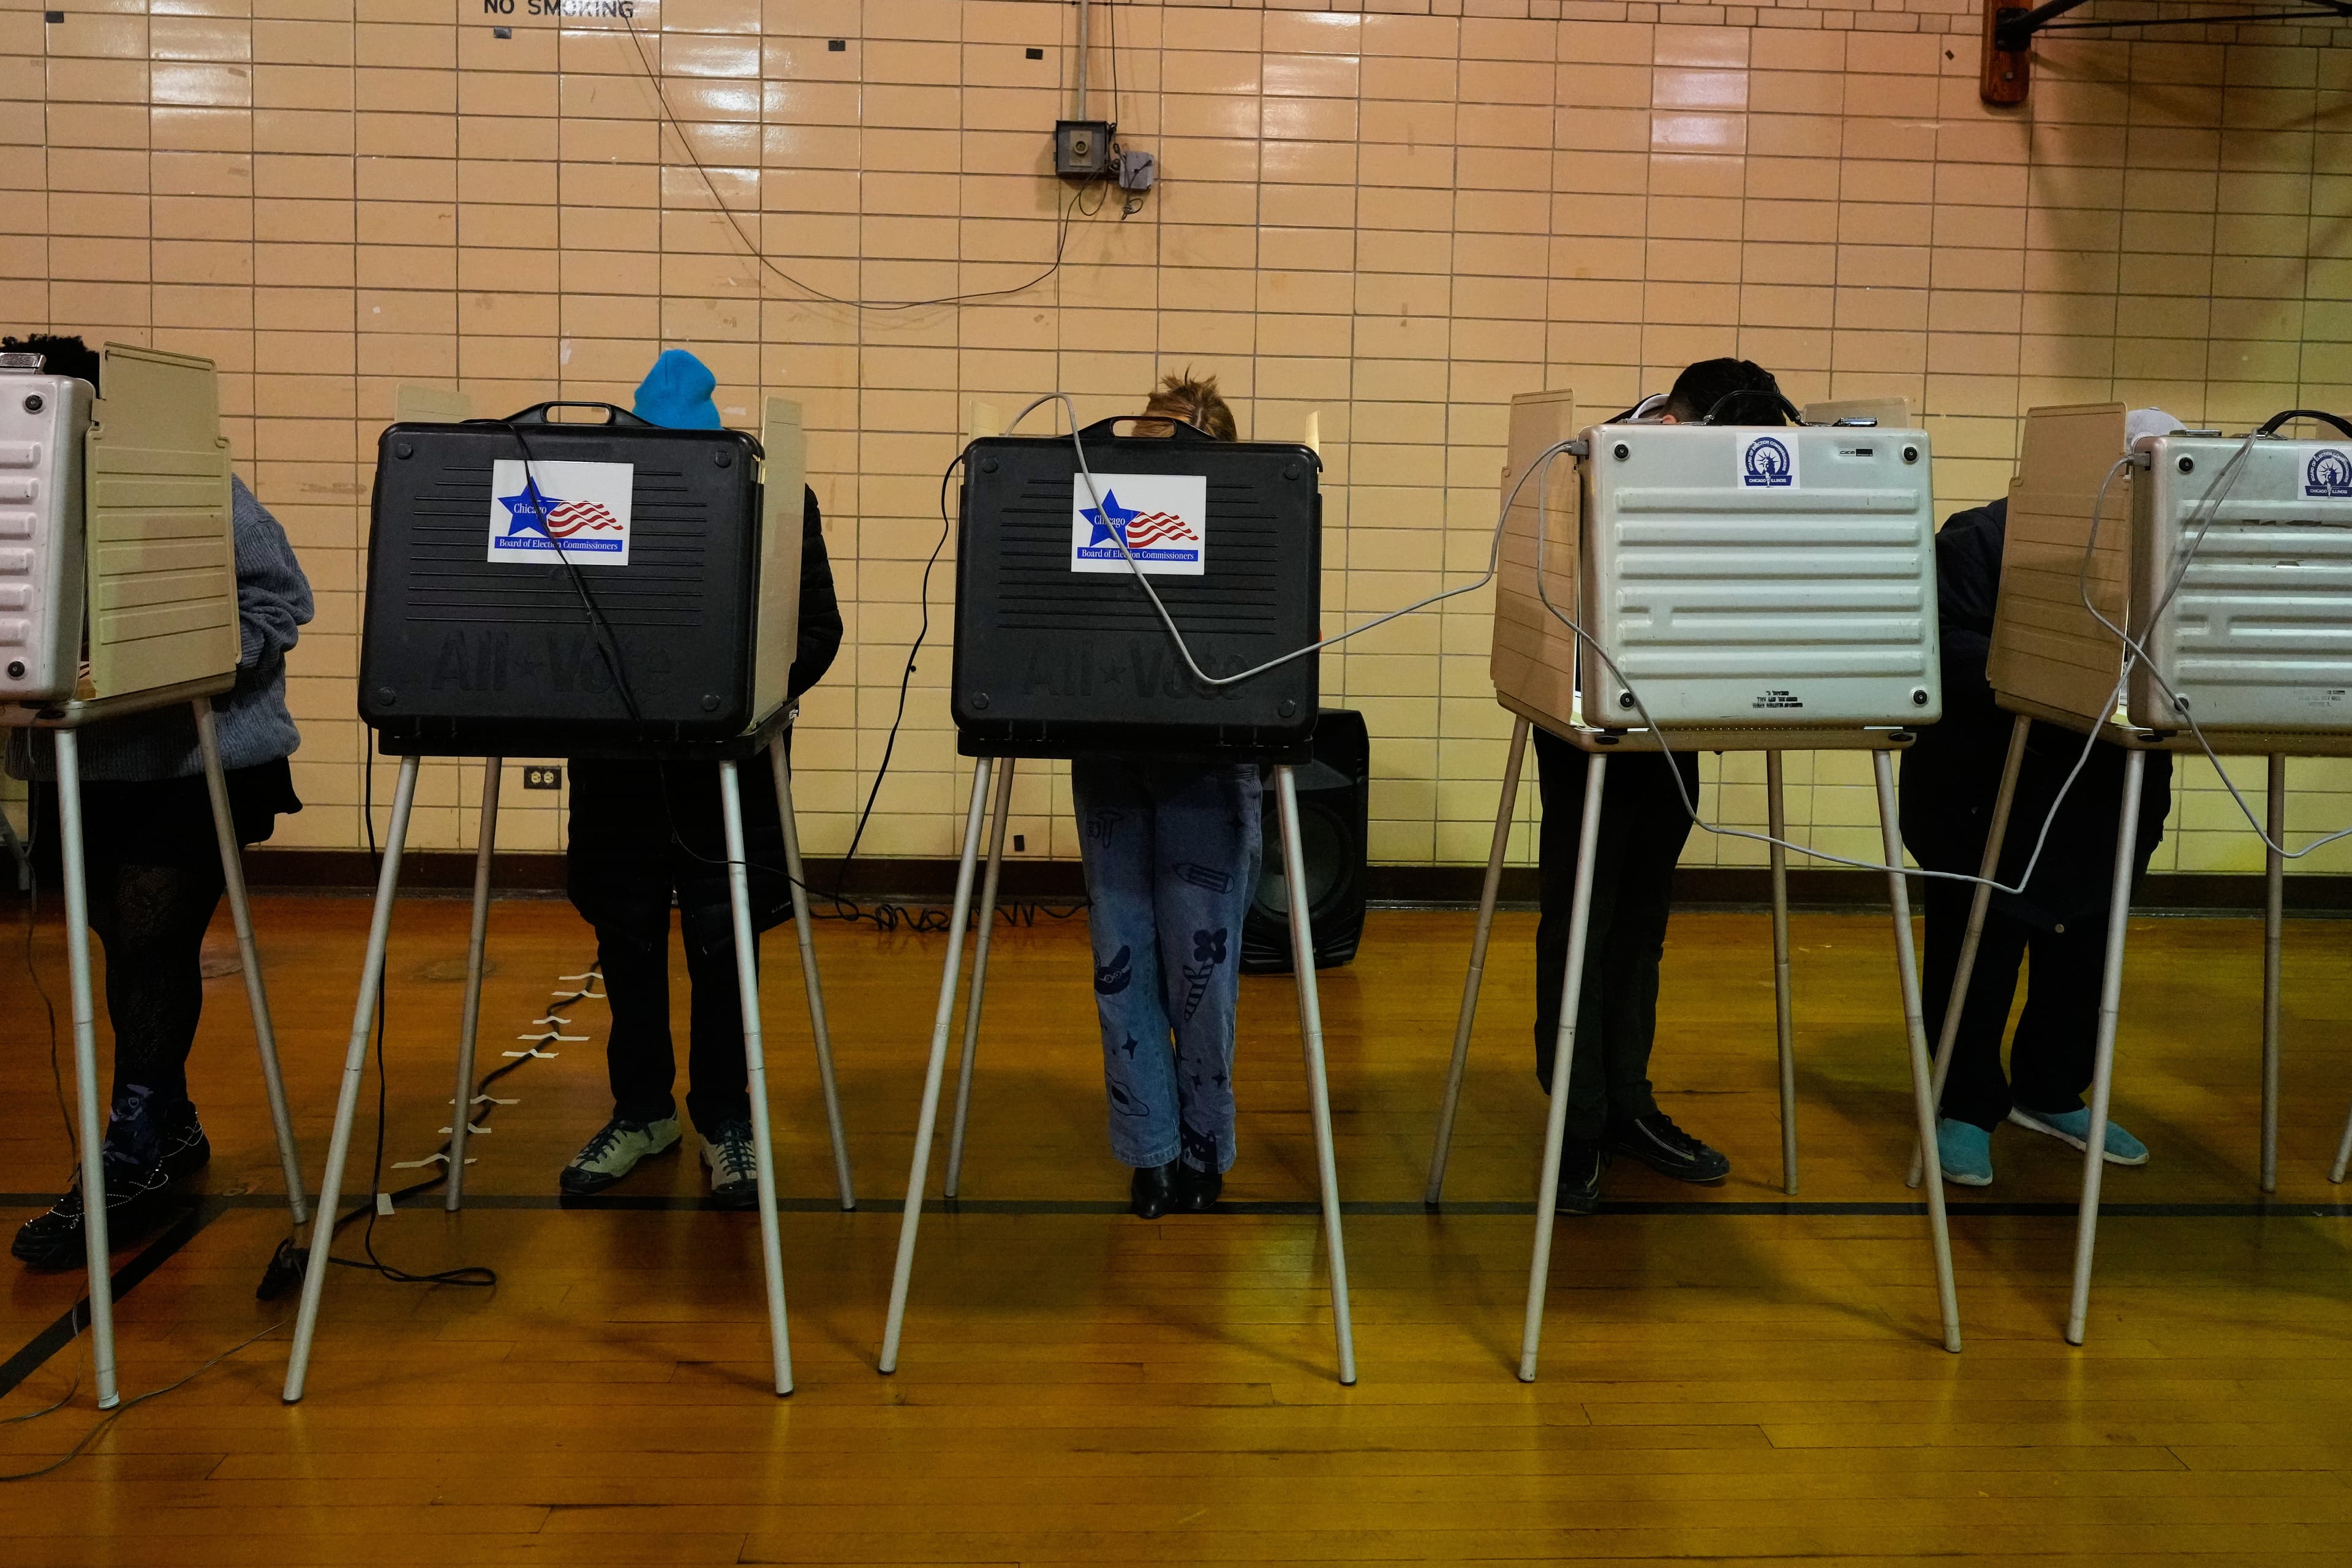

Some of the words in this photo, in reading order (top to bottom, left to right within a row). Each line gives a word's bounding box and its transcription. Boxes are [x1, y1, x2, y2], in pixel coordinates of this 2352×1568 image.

[484, 0, 514, 14] NO
[528, 0, 634, 18] SMOKING
[513, 503, 547, 516] Chicao
[563, 541, 618, 550] Commissioners
[1142, 551, 1194, 559] Commissioners
